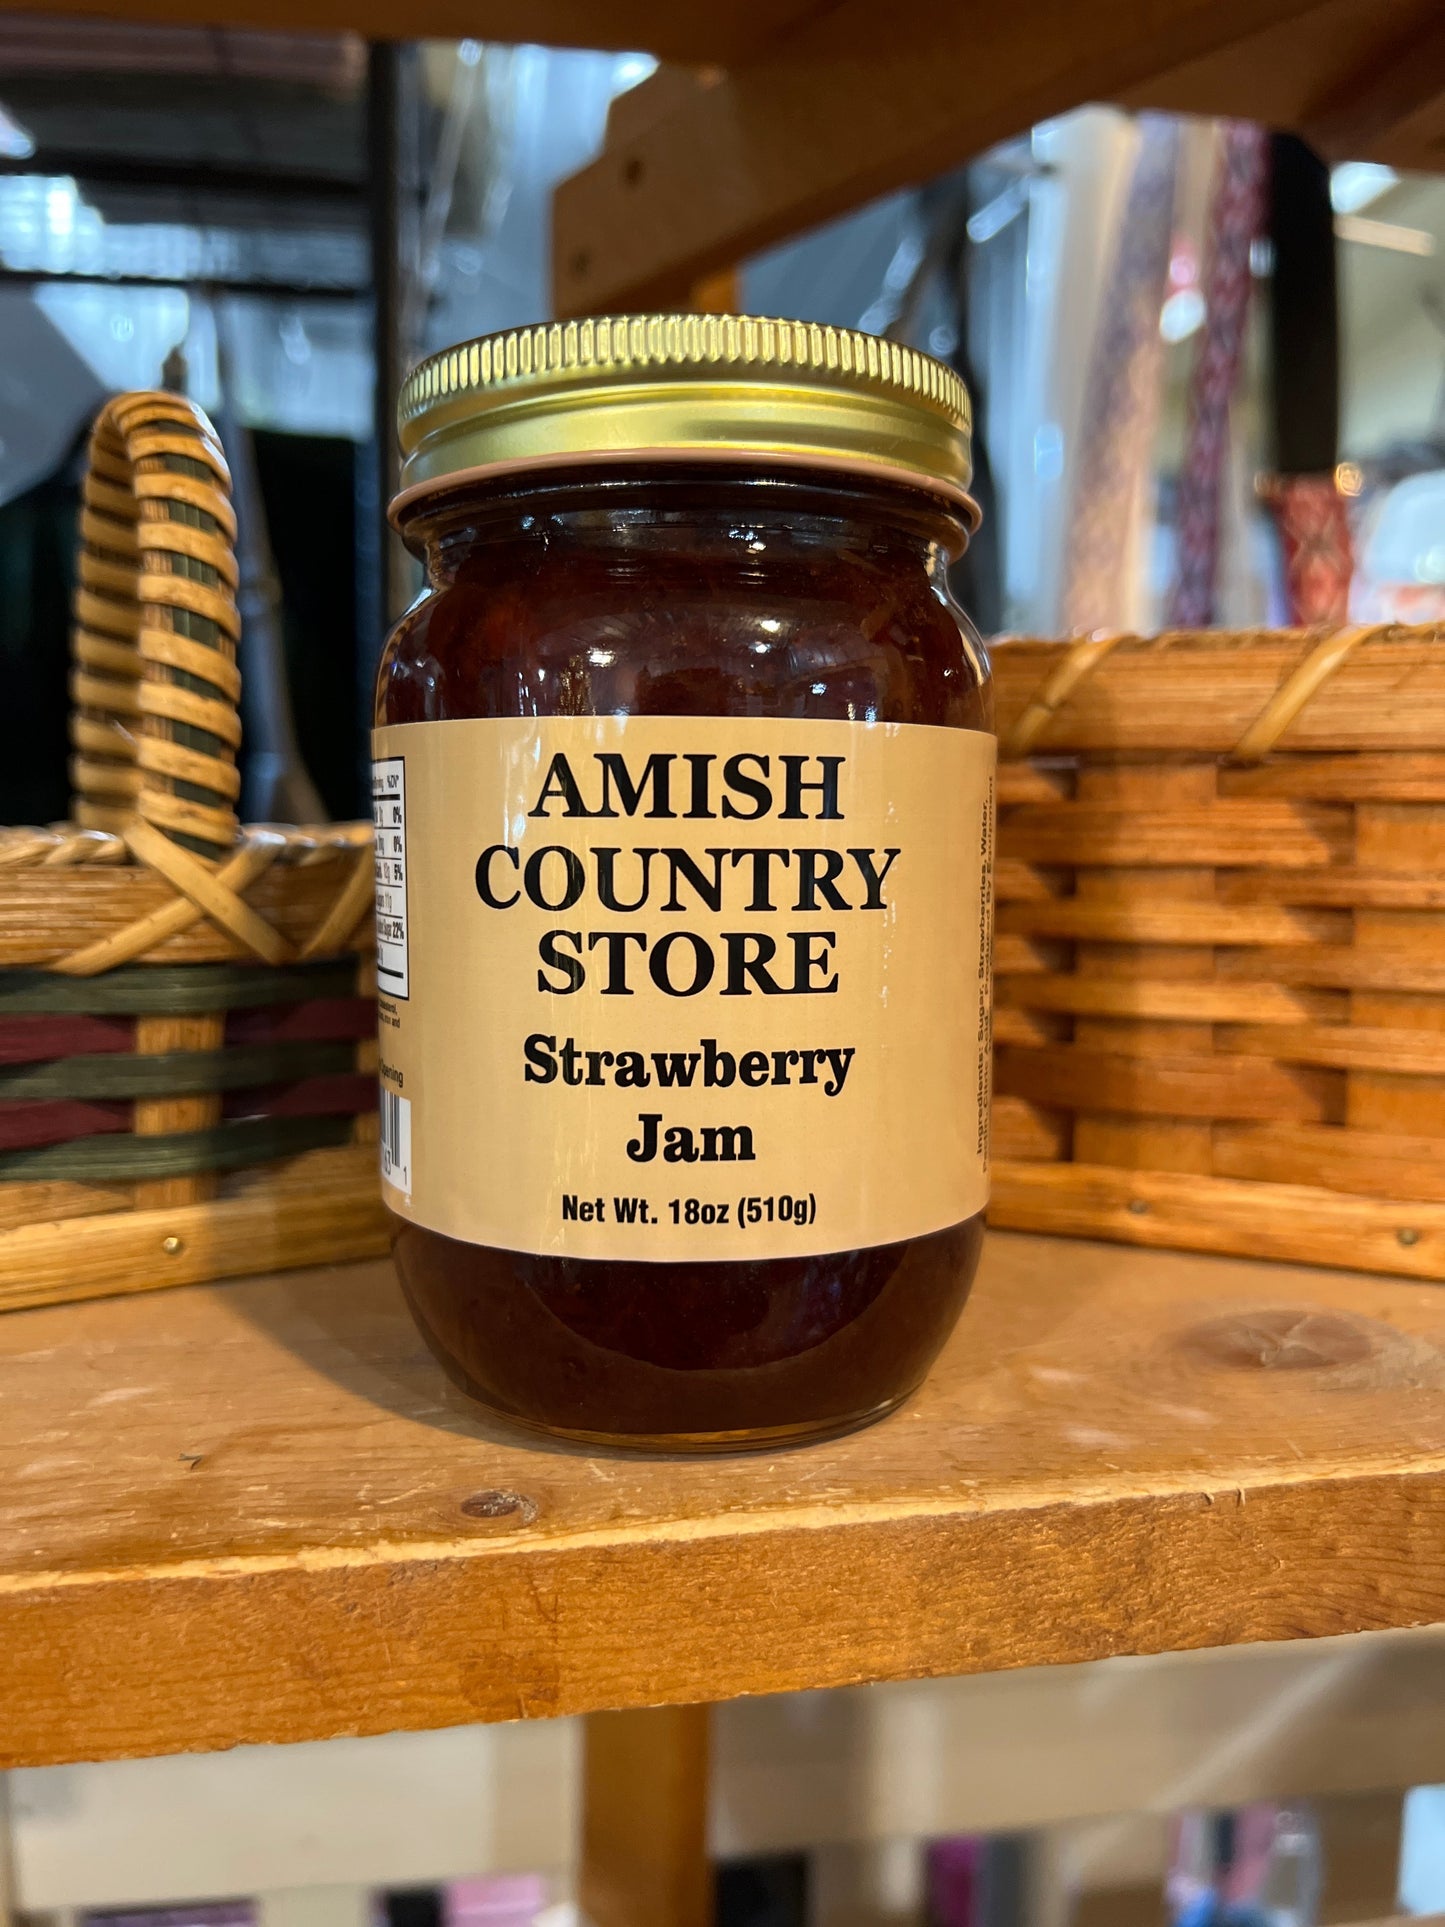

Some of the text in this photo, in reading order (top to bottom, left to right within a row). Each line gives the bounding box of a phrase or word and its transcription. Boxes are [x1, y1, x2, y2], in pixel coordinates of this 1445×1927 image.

[528, 753, 845, 820] AMISH
[476, 845, 901, 912] COUNTRY
[978, 859, 987, 979] Strawberries,
[538, 930, 838, 996] STORE
[524, 1034, 855, 1096] Strawberry
[977, 1046, 985, 1154] Ingredients:
[627, 1114, 755, 1162] Jam
[563, 1194, 816, 1229] Net Wt. 18oz (510g)
